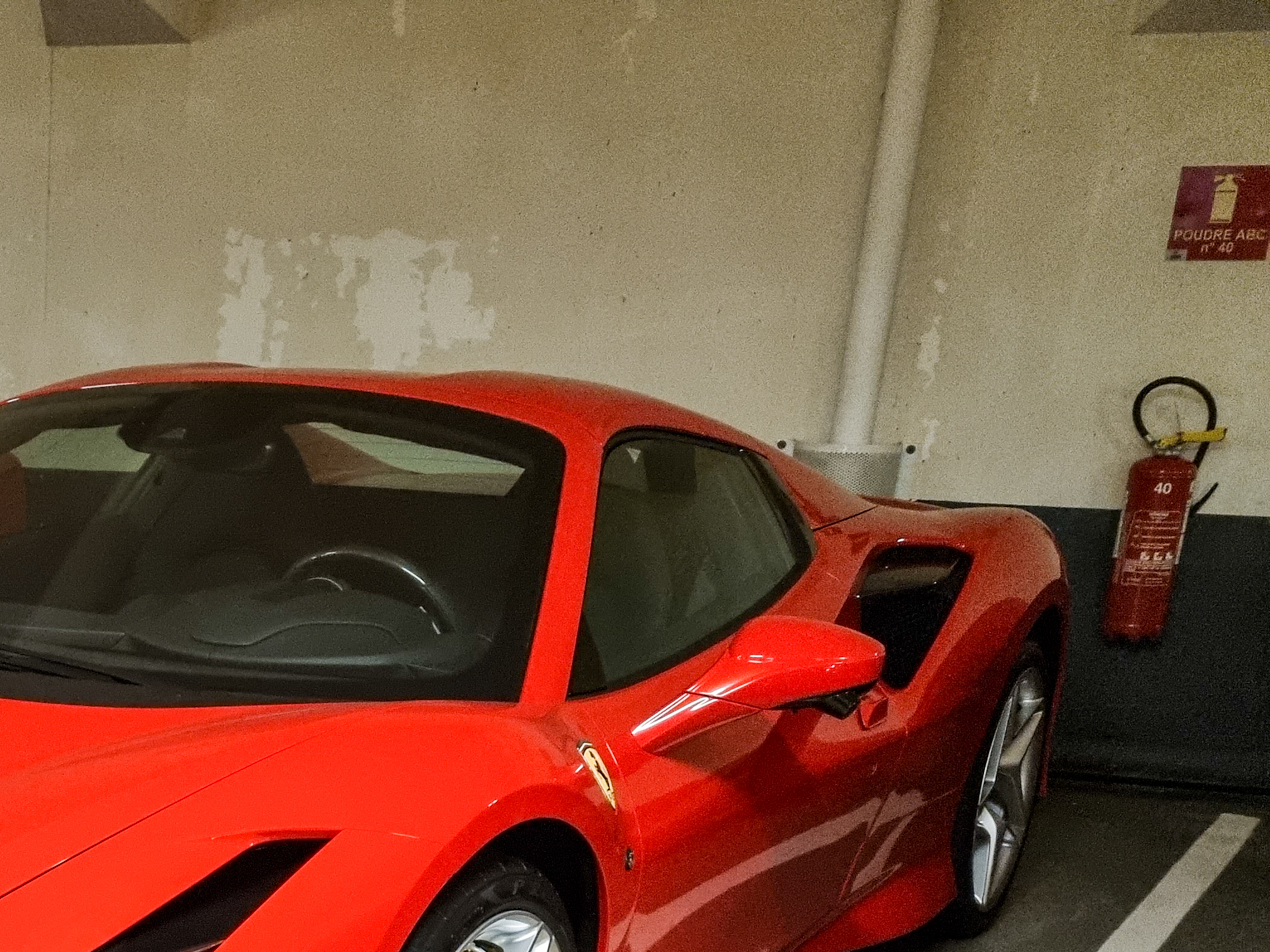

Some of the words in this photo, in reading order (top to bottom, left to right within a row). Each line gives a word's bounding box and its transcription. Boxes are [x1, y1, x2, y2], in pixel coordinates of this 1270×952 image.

[1173, 229, 1233, 241] POUDRE
[1235, 229, 1267, 240] ABC
[1218, 241, 1234, 253] 40
[1153, 482, 1172, 494] 40
